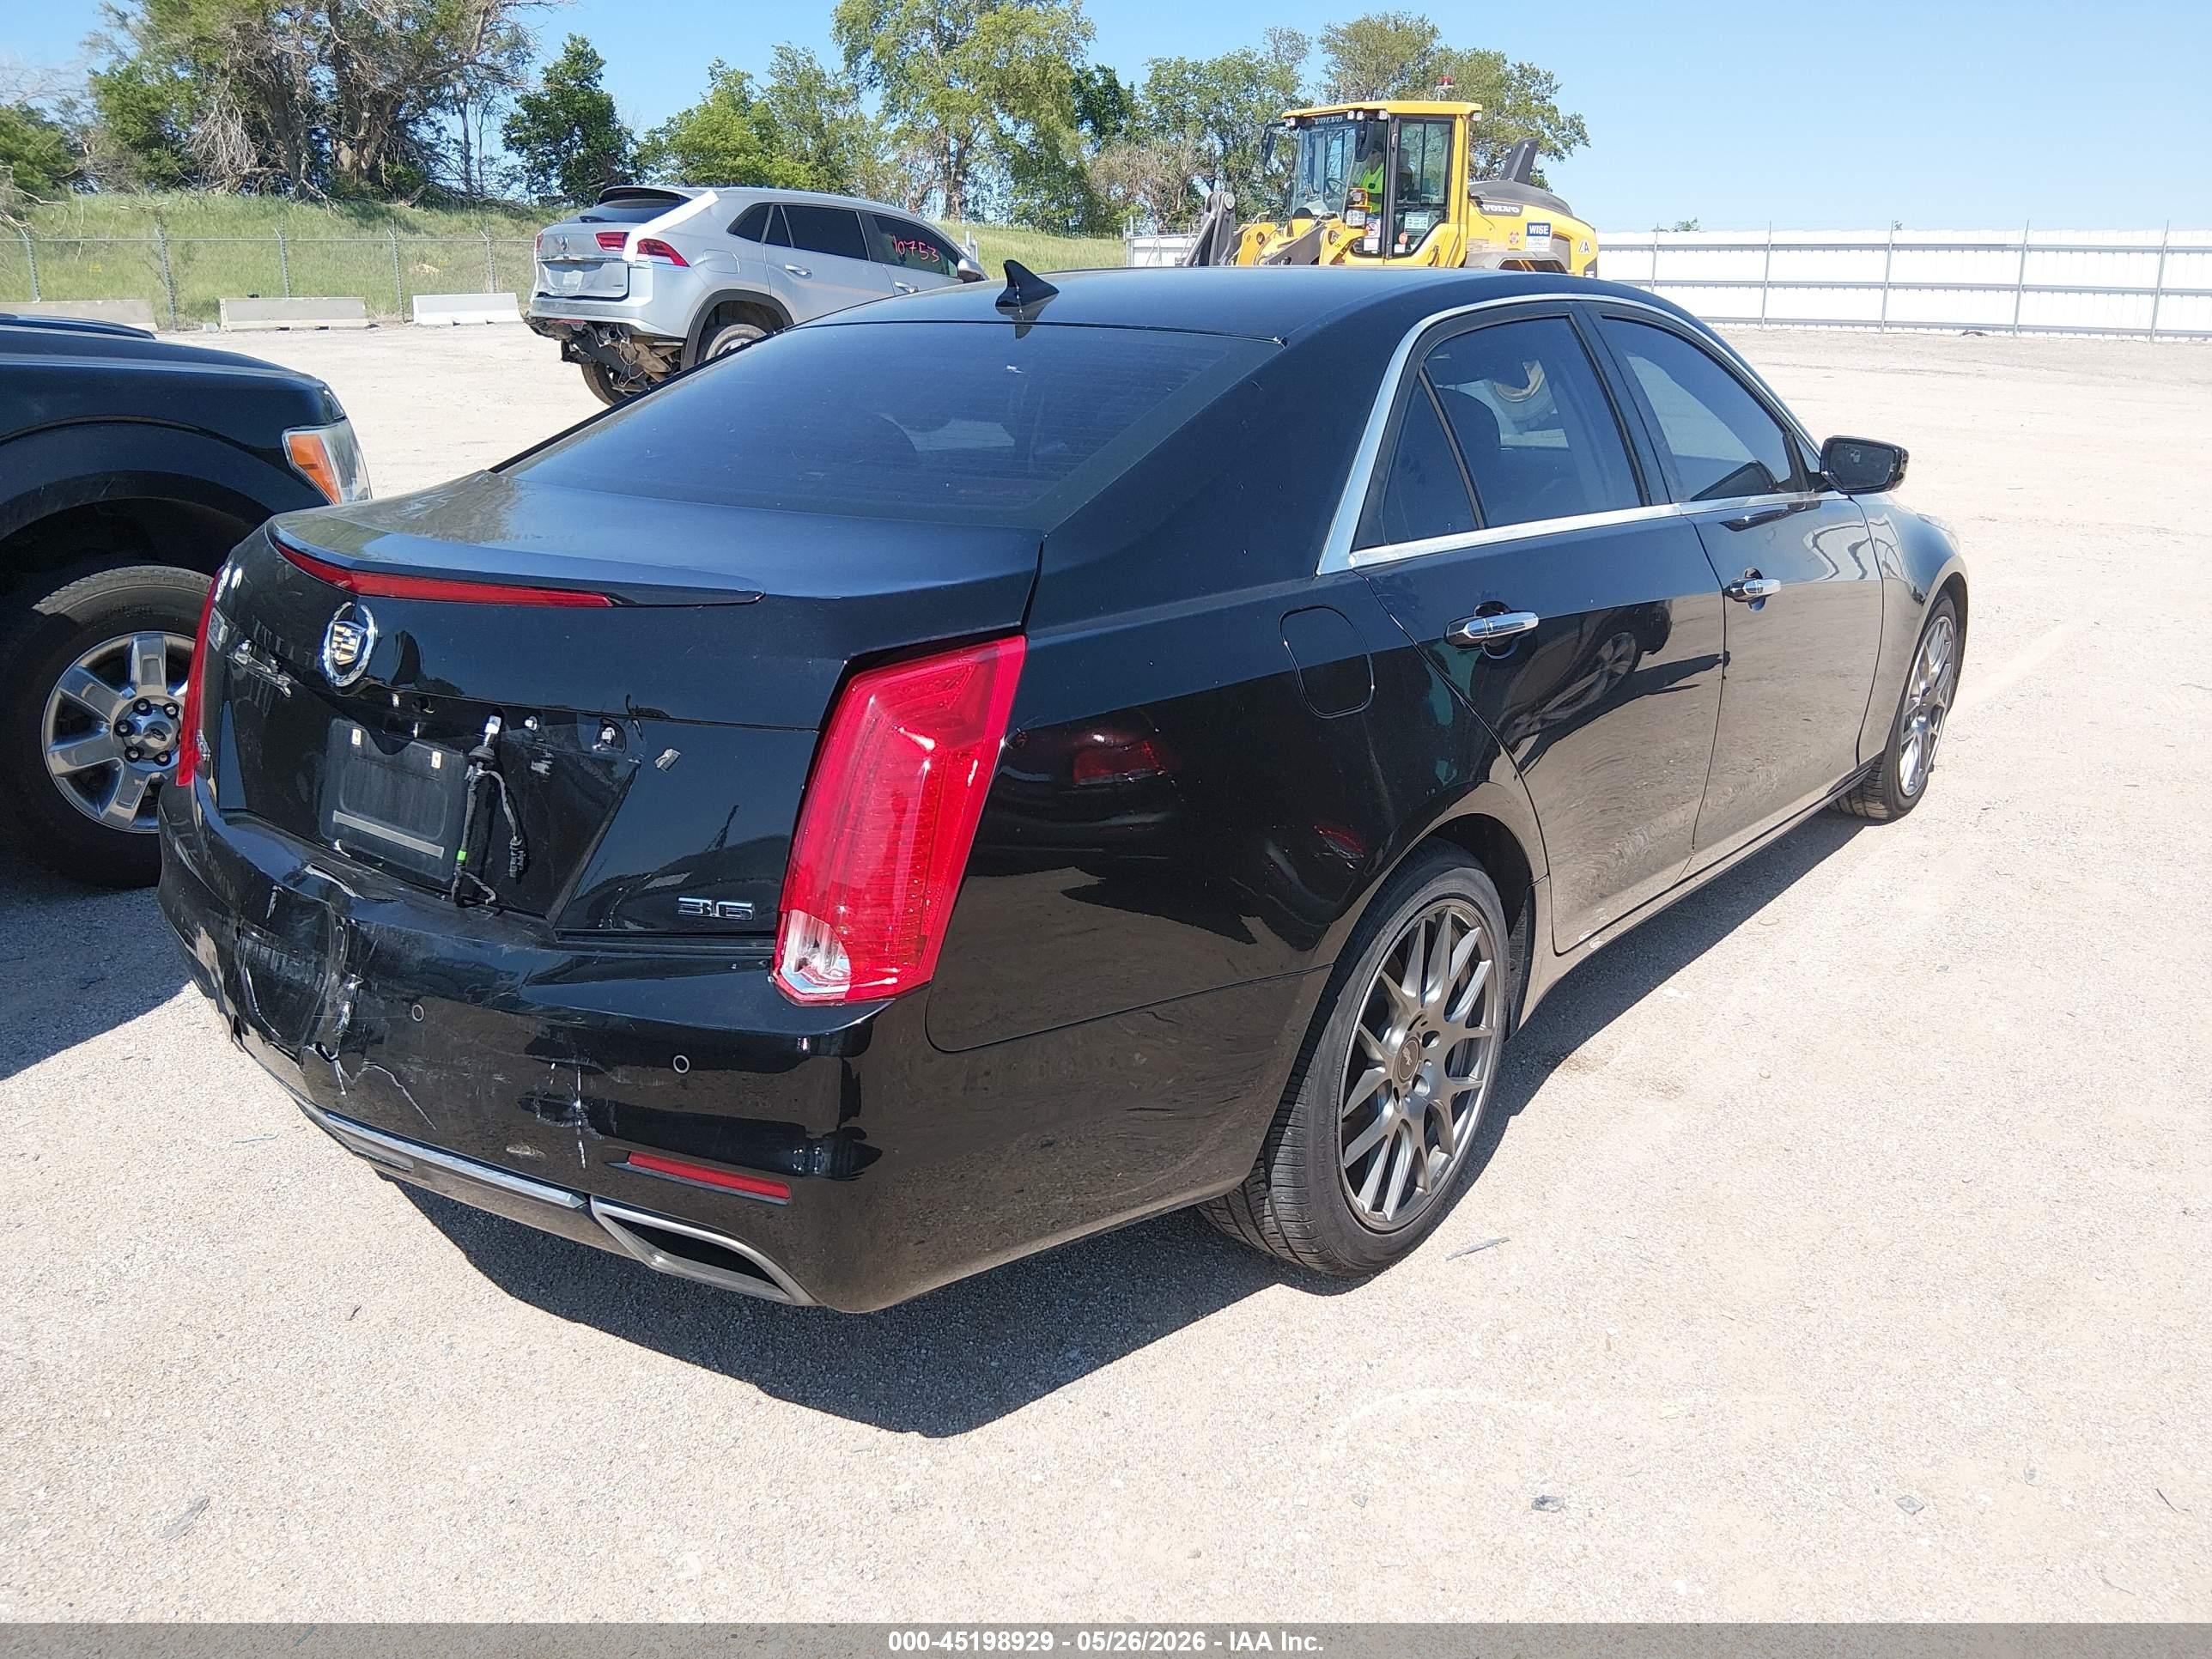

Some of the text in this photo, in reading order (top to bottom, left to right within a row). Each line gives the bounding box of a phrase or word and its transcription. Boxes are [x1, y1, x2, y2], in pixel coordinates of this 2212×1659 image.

[1482, 204, 1520, 214] VOLVO
[1528, 224, 1549, 235] WISE
[892, 234, 940, 263] 10753
[678, 896, 755, 921] 3.6
